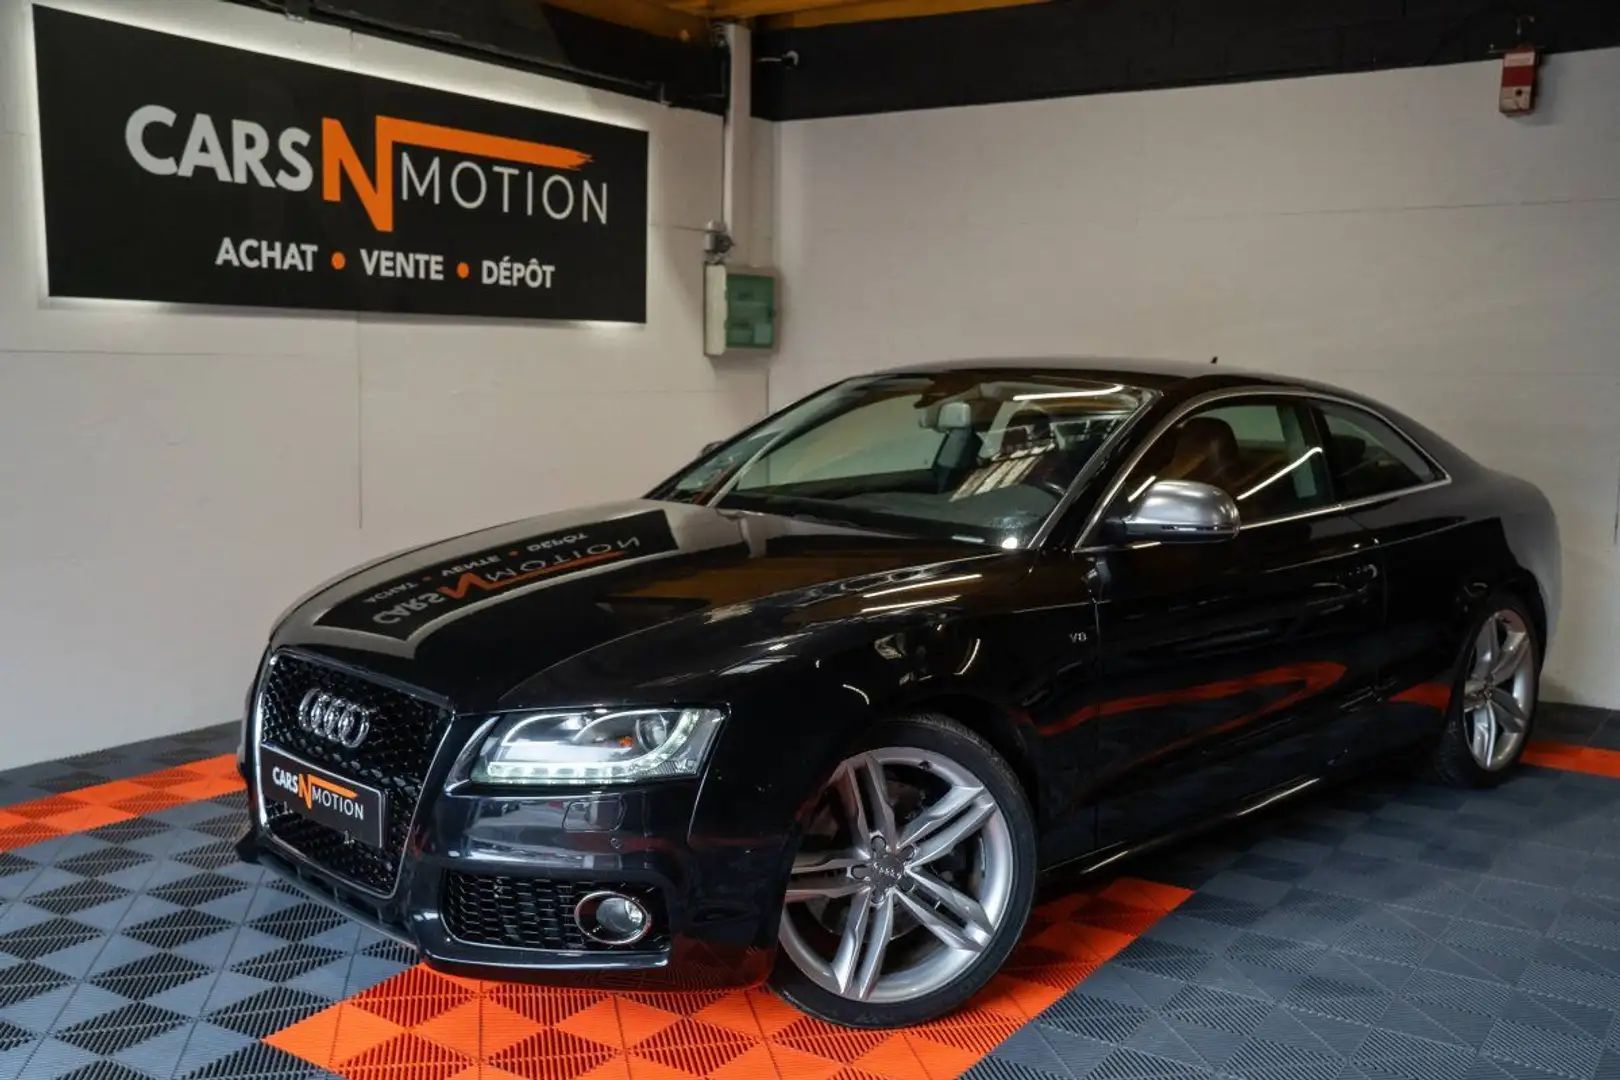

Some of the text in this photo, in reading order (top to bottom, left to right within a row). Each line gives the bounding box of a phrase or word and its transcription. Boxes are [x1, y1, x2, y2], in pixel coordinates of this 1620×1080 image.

[214, 236, 556, 289] ACHAT VENTE DÉPÔT
